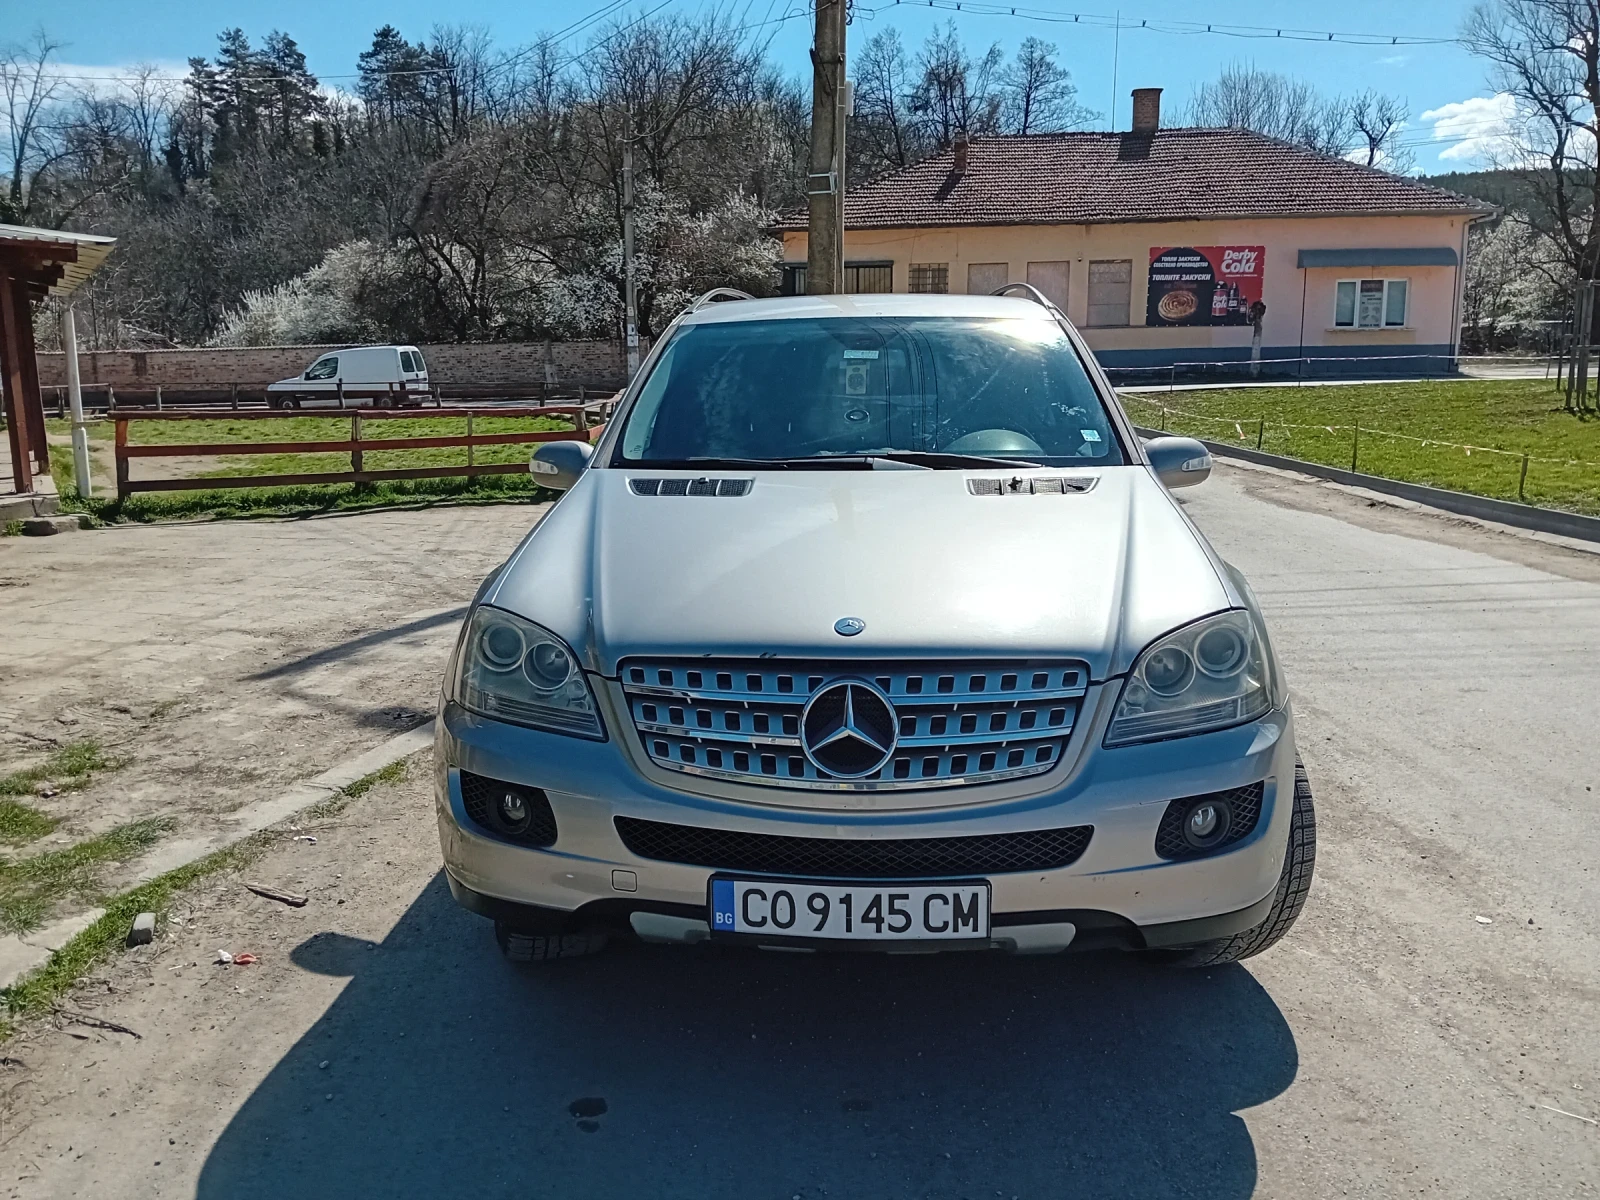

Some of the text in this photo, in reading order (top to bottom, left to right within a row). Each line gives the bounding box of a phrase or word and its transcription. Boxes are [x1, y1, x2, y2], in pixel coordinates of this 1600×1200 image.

[1224, 249, 1258, 262] Derby
[1221, 259, 1256, 273] Cola
[742, 889, 979, 933] CO 9145 CM
[715, 912, 733, 924] BG
